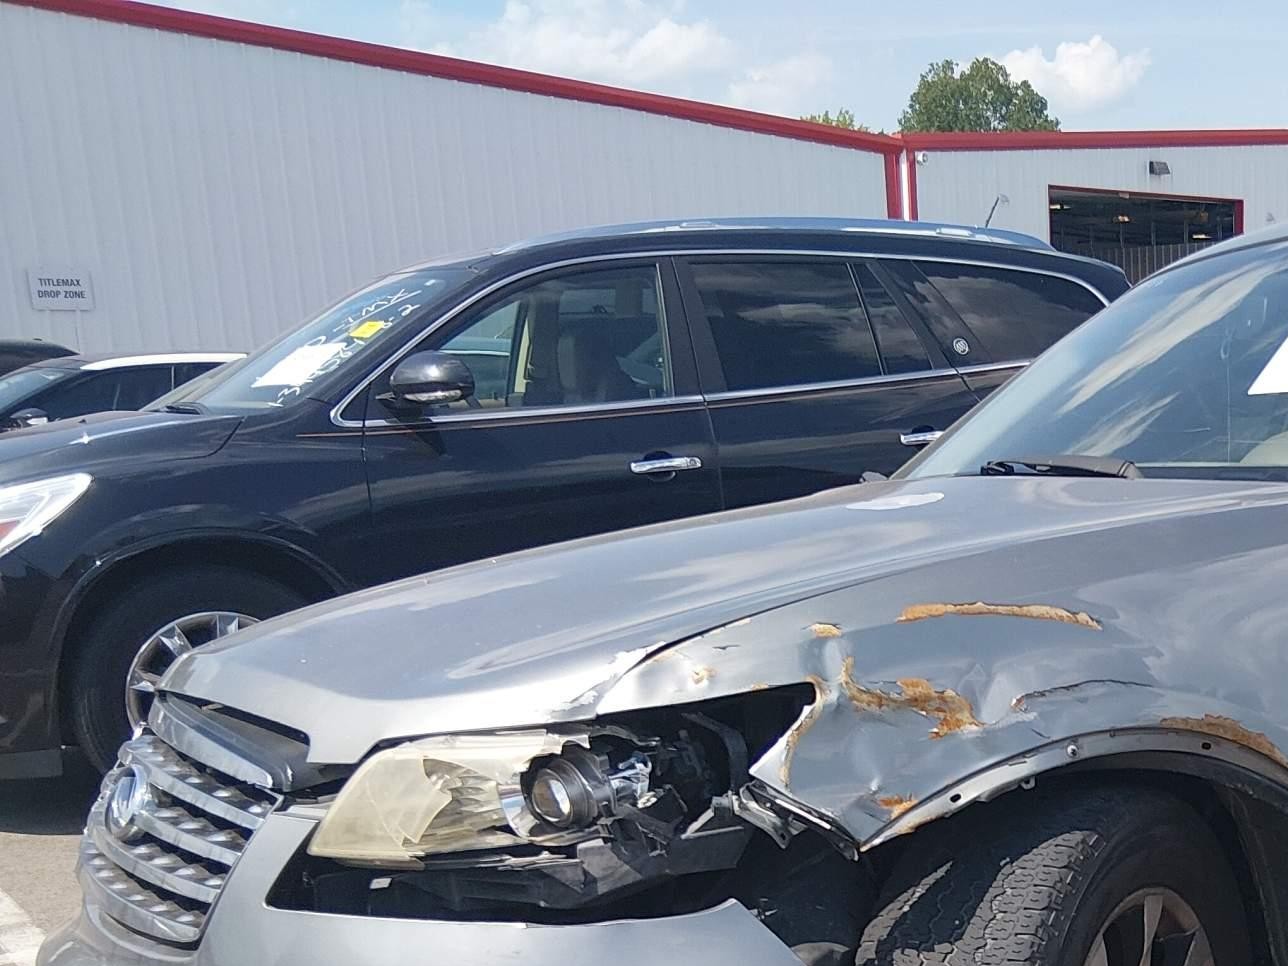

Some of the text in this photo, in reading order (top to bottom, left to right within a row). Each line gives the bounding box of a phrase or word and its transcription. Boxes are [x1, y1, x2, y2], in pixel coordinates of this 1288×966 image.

[38, 278, 81, 287] TITLEMAX
[37, 289, 87, 299] DROP ZONE
